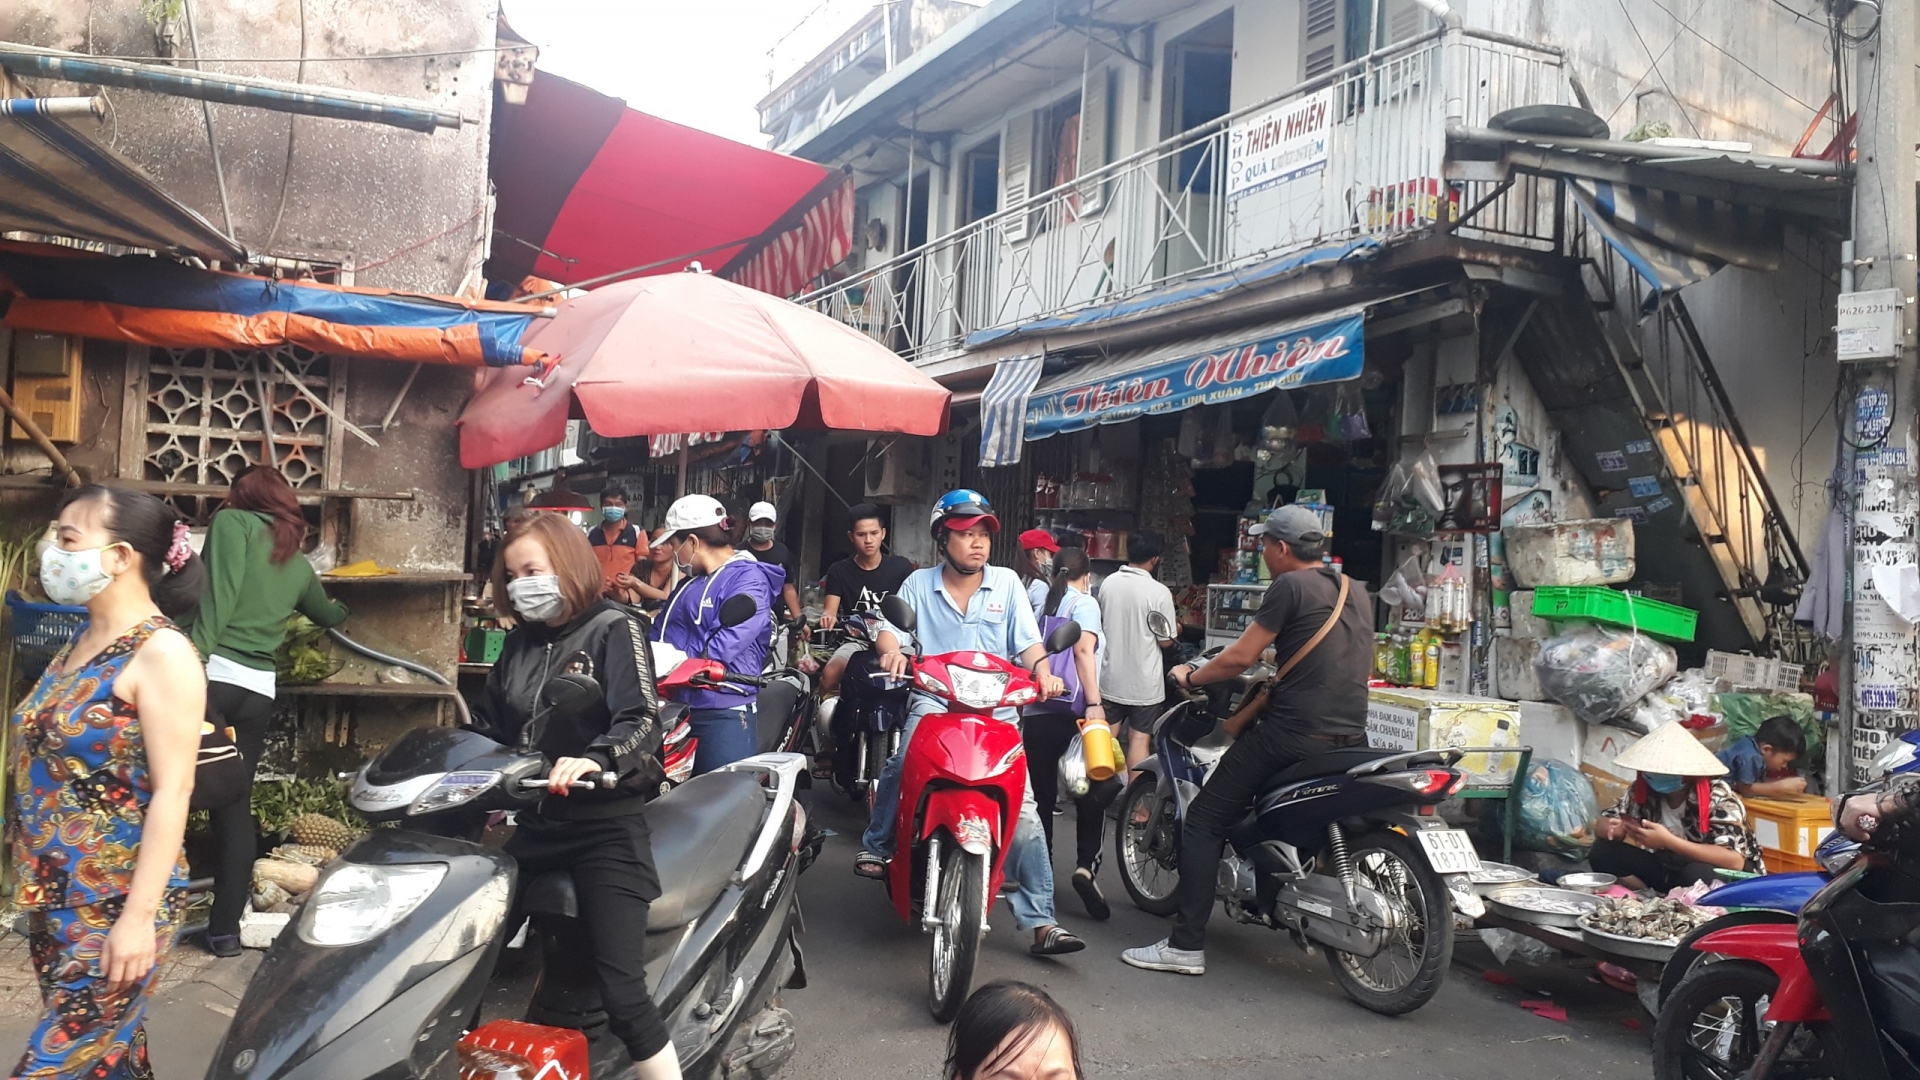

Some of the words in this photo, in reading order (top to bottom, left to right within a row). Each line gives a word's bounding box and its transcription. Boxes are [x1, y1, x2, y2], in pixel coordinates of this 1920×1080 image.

[1246, 114, 1282, 157] THIÊN
[1284, 97, 1327, 142] NHIÊN
[1230, 129, 1243, 191] SHOP
[1866, 304, 1884, 315] 221
[1886, 303, 1893, 312] H
[1061, 377, 1173, 419] Thiên
[1185, 336, 1351, 389] Nhiên
[1181, 393, 1206, 406] LINH
[1209, 385, 1243, 400] XUÂN
[777, 726, 793, 753] OUVO
[1379, 724, 1401, 738] CHANH
[1854, 728, 1881, 745] CHO
[1426, 832, 1466, 850] 61-D1
[1432, 851, 1480, 870] 18370
